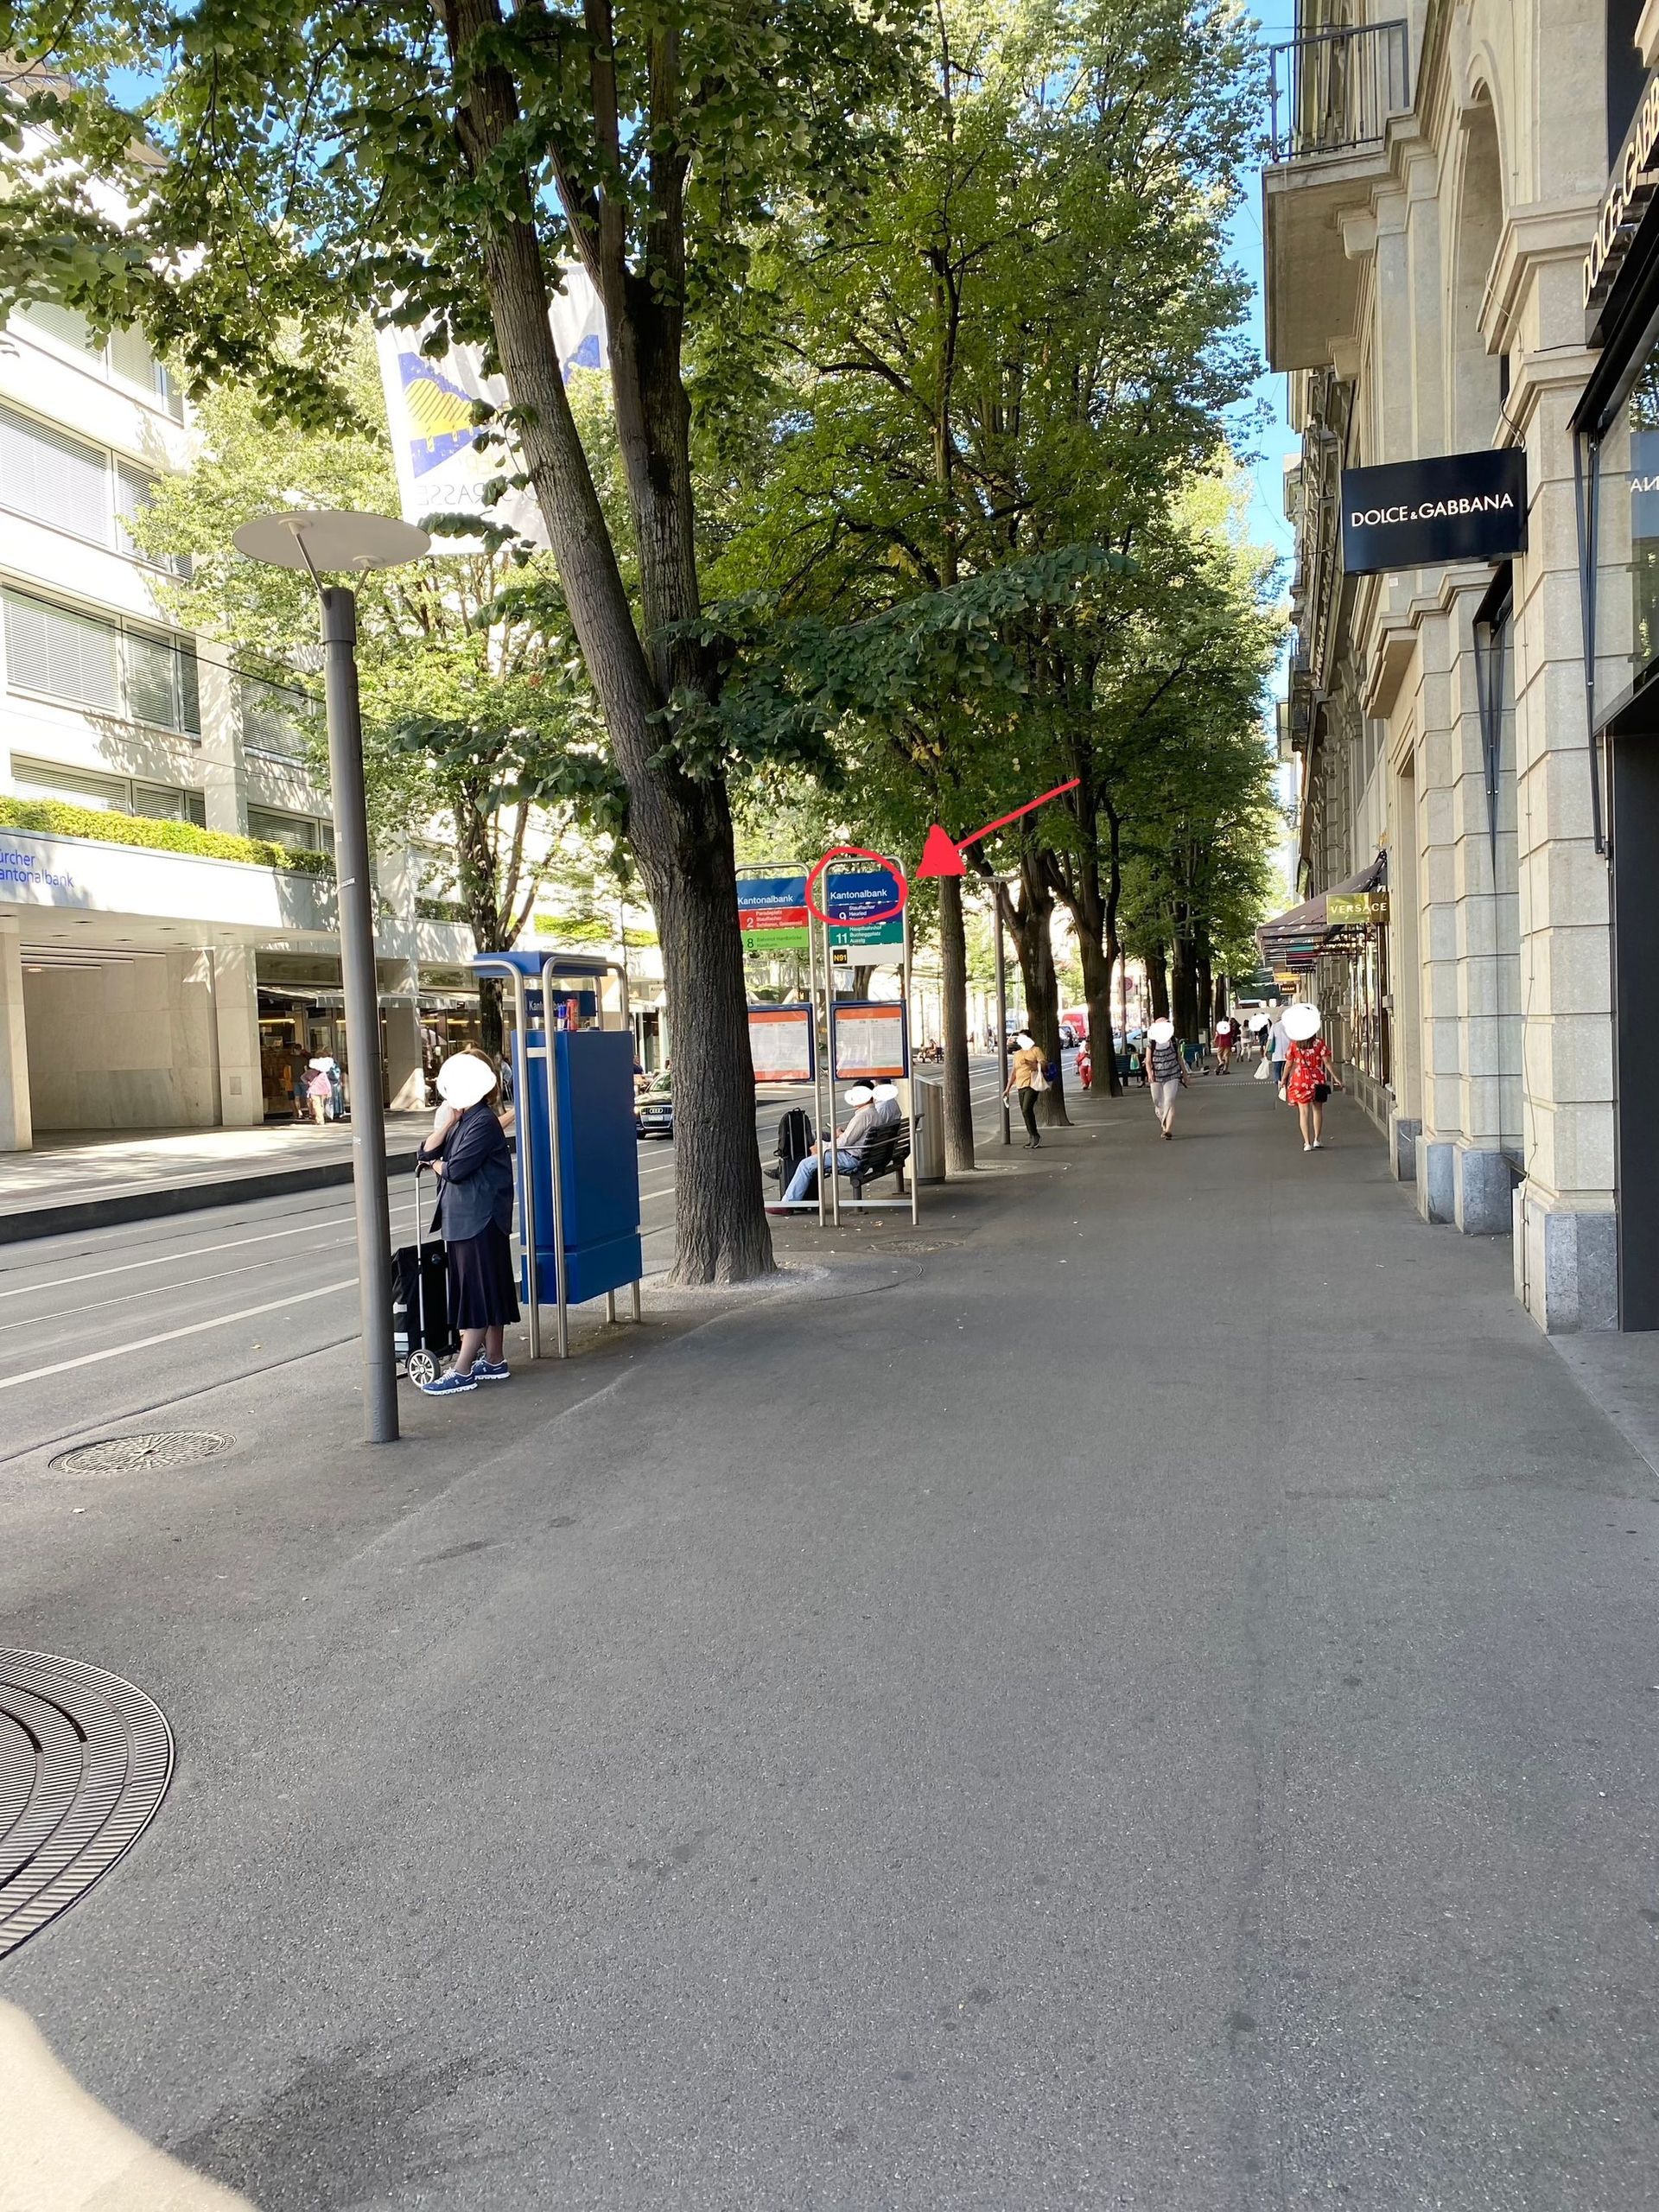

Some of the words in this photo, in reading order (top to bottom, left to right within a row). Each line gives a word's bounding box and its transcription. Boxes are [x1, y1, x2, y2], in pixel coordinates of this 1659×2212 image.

[738, 894, 793, 906] Kantonalbank
[830, 889, 887, 900] Kantonalbank
[1330, 902, 1388, 914] VERSACE
[838, 912, 847, 920] 9
[747, 917, 754, 928] 2
[747, 938, 754, 949] 8
[836, 933, 848, 944] 11
[833, 953, 848, 963] N91
